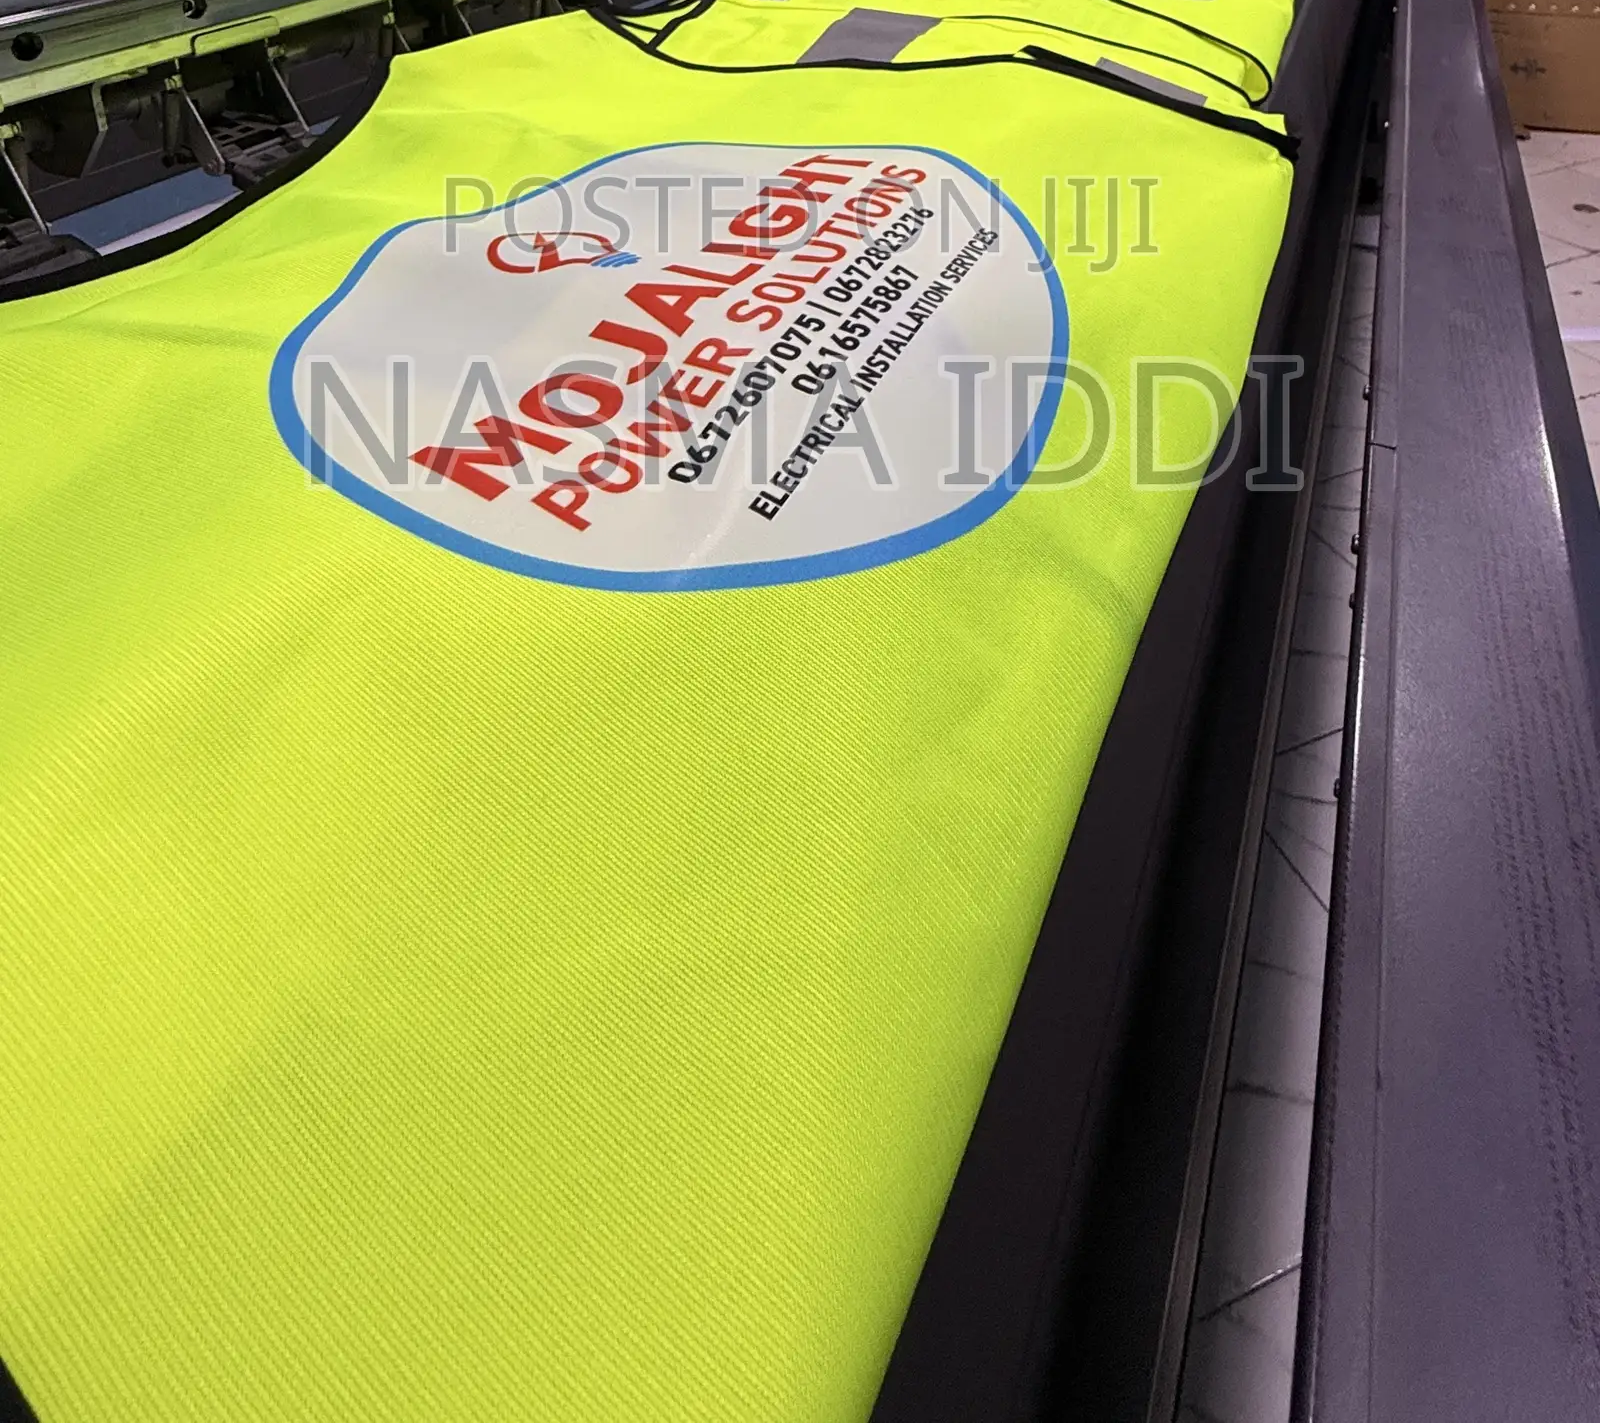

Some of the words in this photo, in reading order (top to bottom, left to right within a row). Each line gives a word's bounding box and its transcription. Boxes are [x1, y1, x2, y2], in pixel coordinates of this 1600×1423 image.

[407, 154, 875, 503] MOJALIGHT
[529, 337, 754, 532] POWER
[725, 164, 927, 332] SOLUTIONS
[667, 313, 826, 484] 0672607075
[823, 205, 935, 304] 0672823276
[747, 393, 866, 521] ELECTRICAL
[849, 279, 954, 394] INSTALLATION
[939, 227, 999, 285] SERVICES
[790, 264, 920, 396] 0616575867
